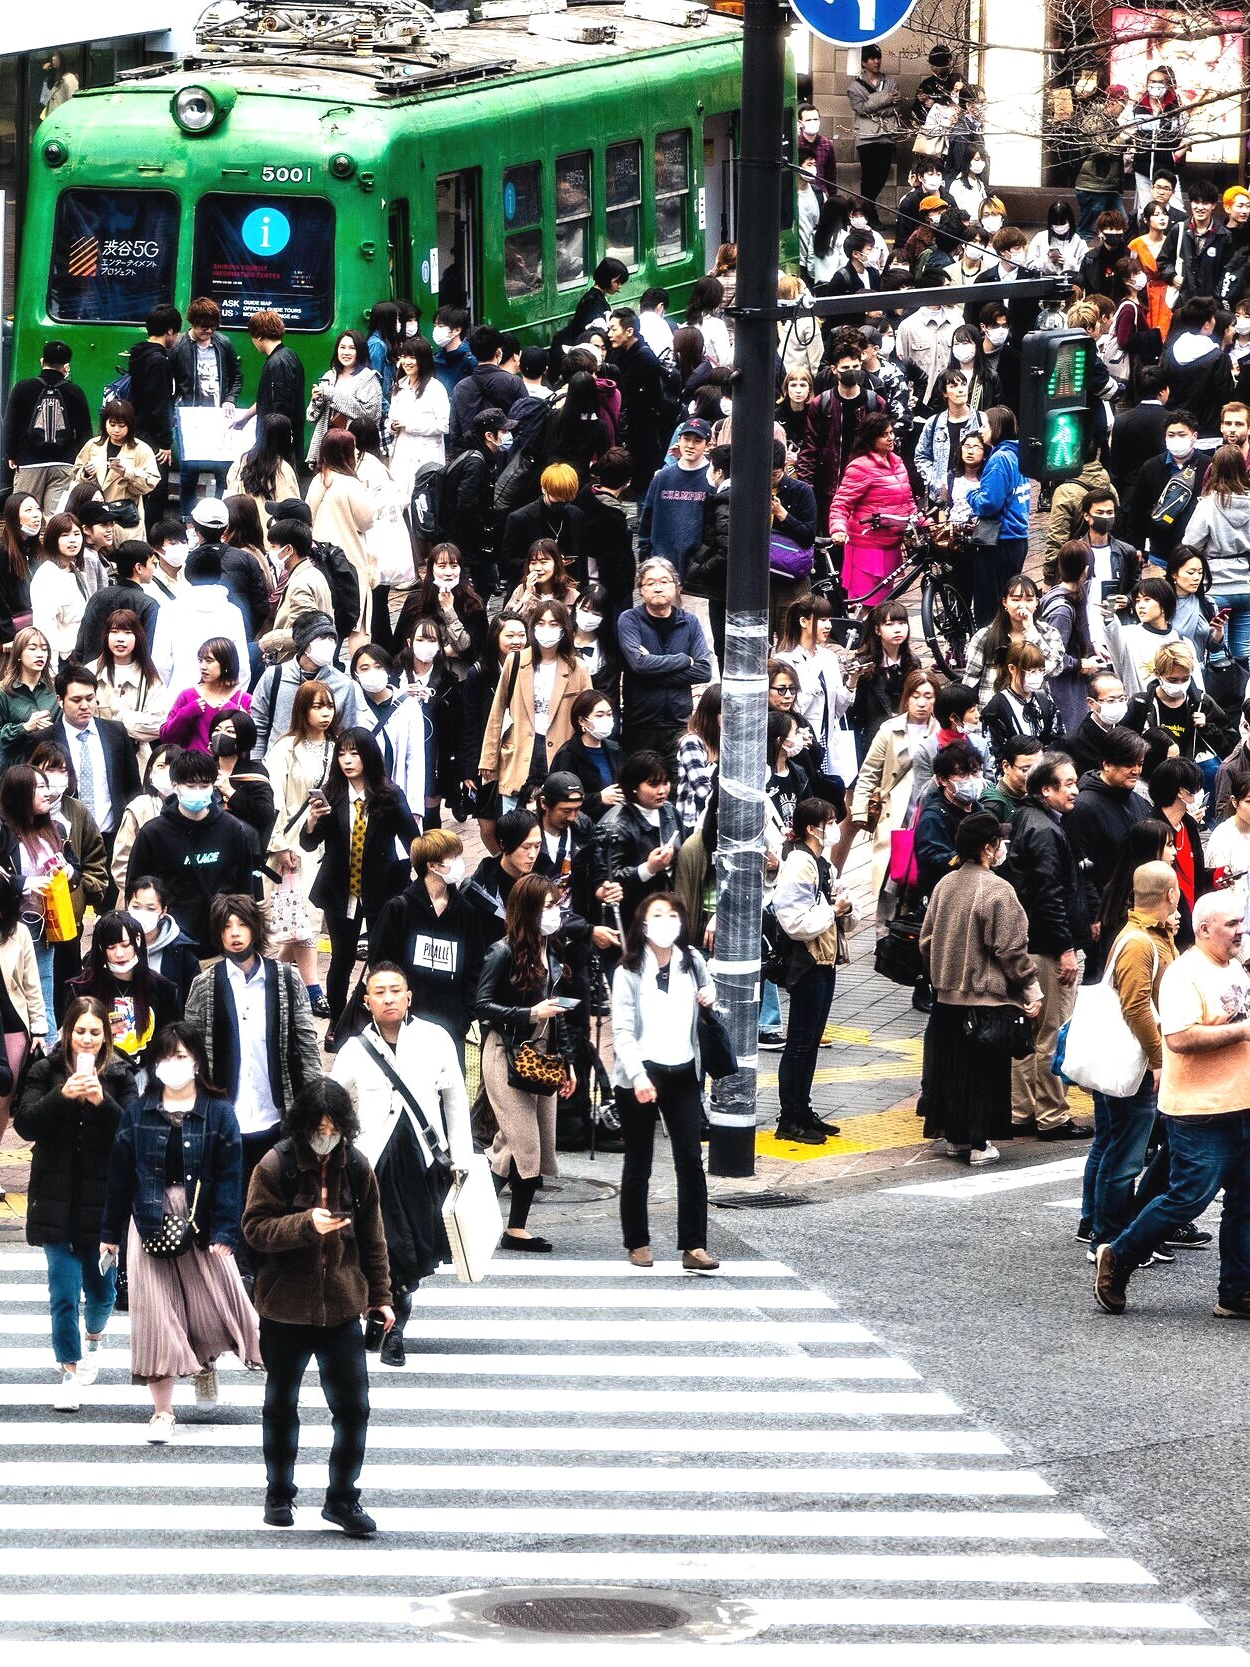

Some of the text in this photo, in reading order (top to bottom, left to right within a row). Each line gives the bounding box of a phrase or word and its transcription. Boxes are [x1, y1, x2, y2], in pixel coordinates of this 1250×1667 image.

[261, 166, 312, 183] 5001
[101, 239, 160, 258] 渋谷5G
[100, 267, 137, 276] プロジェクト
[222, 300, 240, 308] ASK
[221, 309, 233, 317] US
